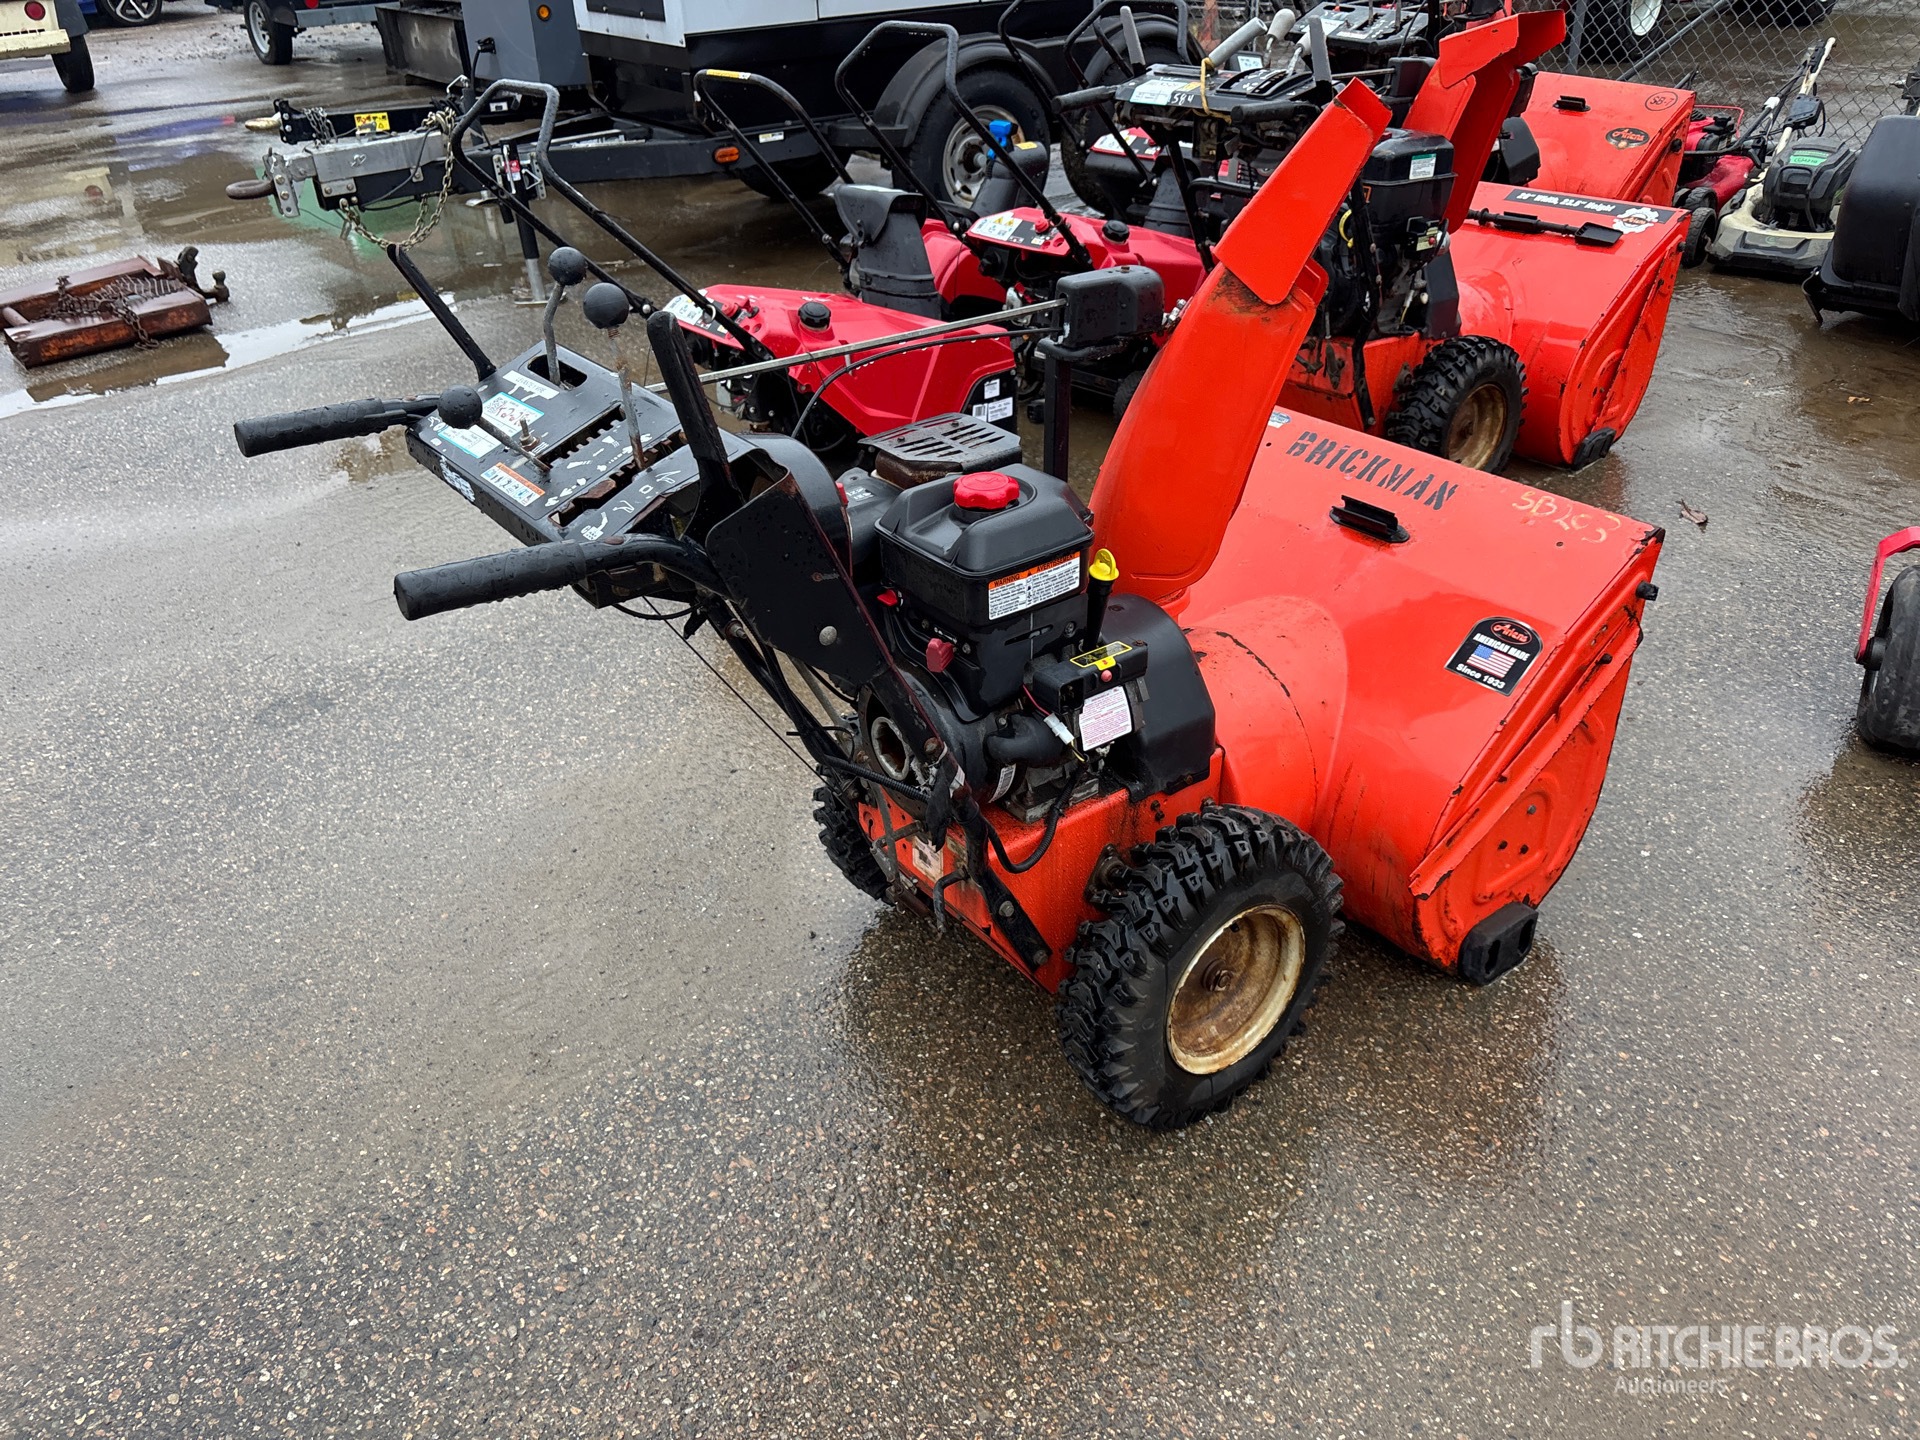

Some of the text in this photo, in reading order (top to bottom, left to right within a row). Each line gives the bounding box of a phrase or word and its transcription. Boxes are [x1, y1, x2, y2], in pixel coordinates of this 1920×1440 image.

[1171, 93, 1195, 106] 584
[1611, 128, 1645, 142] Ariens
[993, 554, 1076, 587] WARNING AVERTISSEMENT
[1493, 624, 1528, 642] Ariens
[1473, 633, 1530, 661] AMERICAN MADE
[1456, 663, 1506, 689] Since 1933
